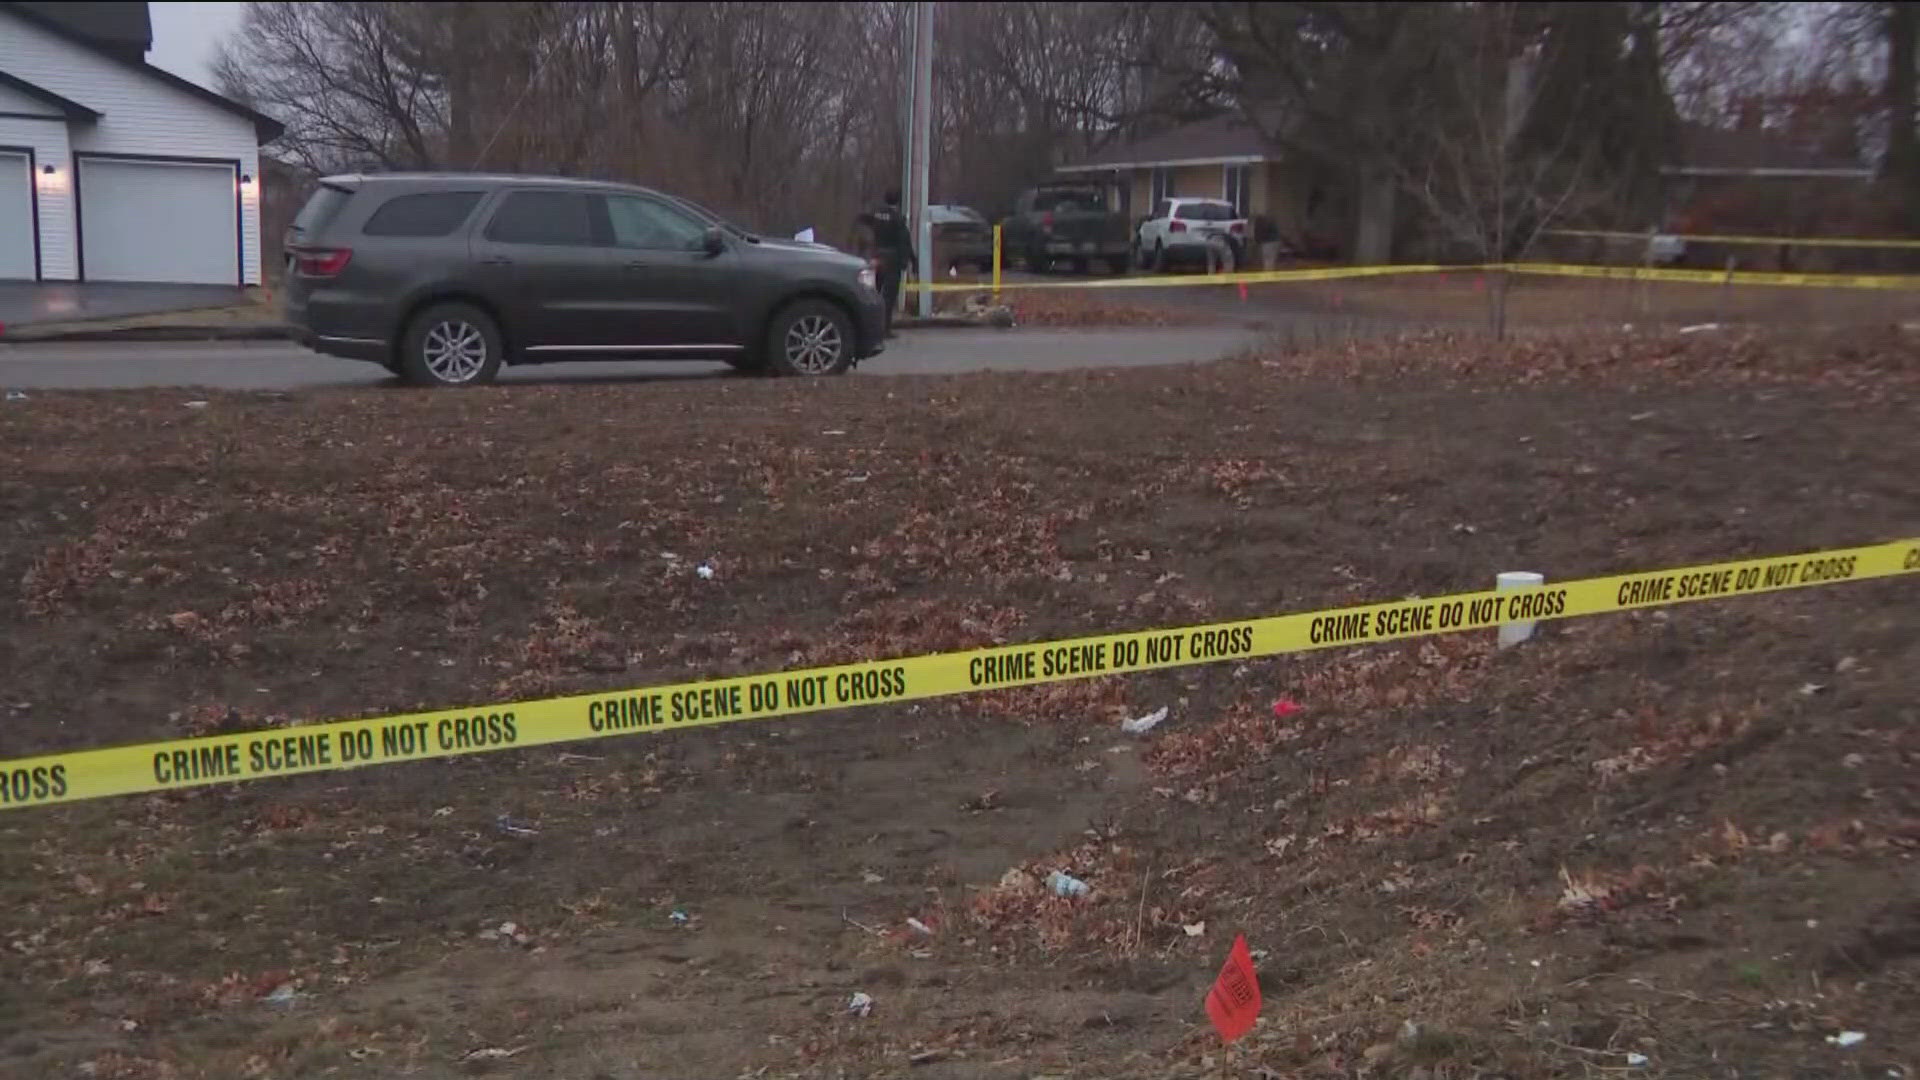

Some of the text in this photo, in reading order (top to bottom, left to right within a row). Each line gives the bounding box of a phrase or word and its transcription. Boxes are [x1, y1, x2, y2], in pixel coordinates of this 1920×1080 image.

[1618, 556, 1857, 606] CRIME SCENE DO NOT CROSS
[1310, 590, 1567, 644] CRIME SCENE DO NOT CROSS
[970, 627, 1253, 685] CRIME SCENE DO NOT CROSS
[589, 667, 905, 731] CRIME SCENE DO NOT CROSS
[153, 712, 517, 785] CRIME SCENE DO NOT CROSS
